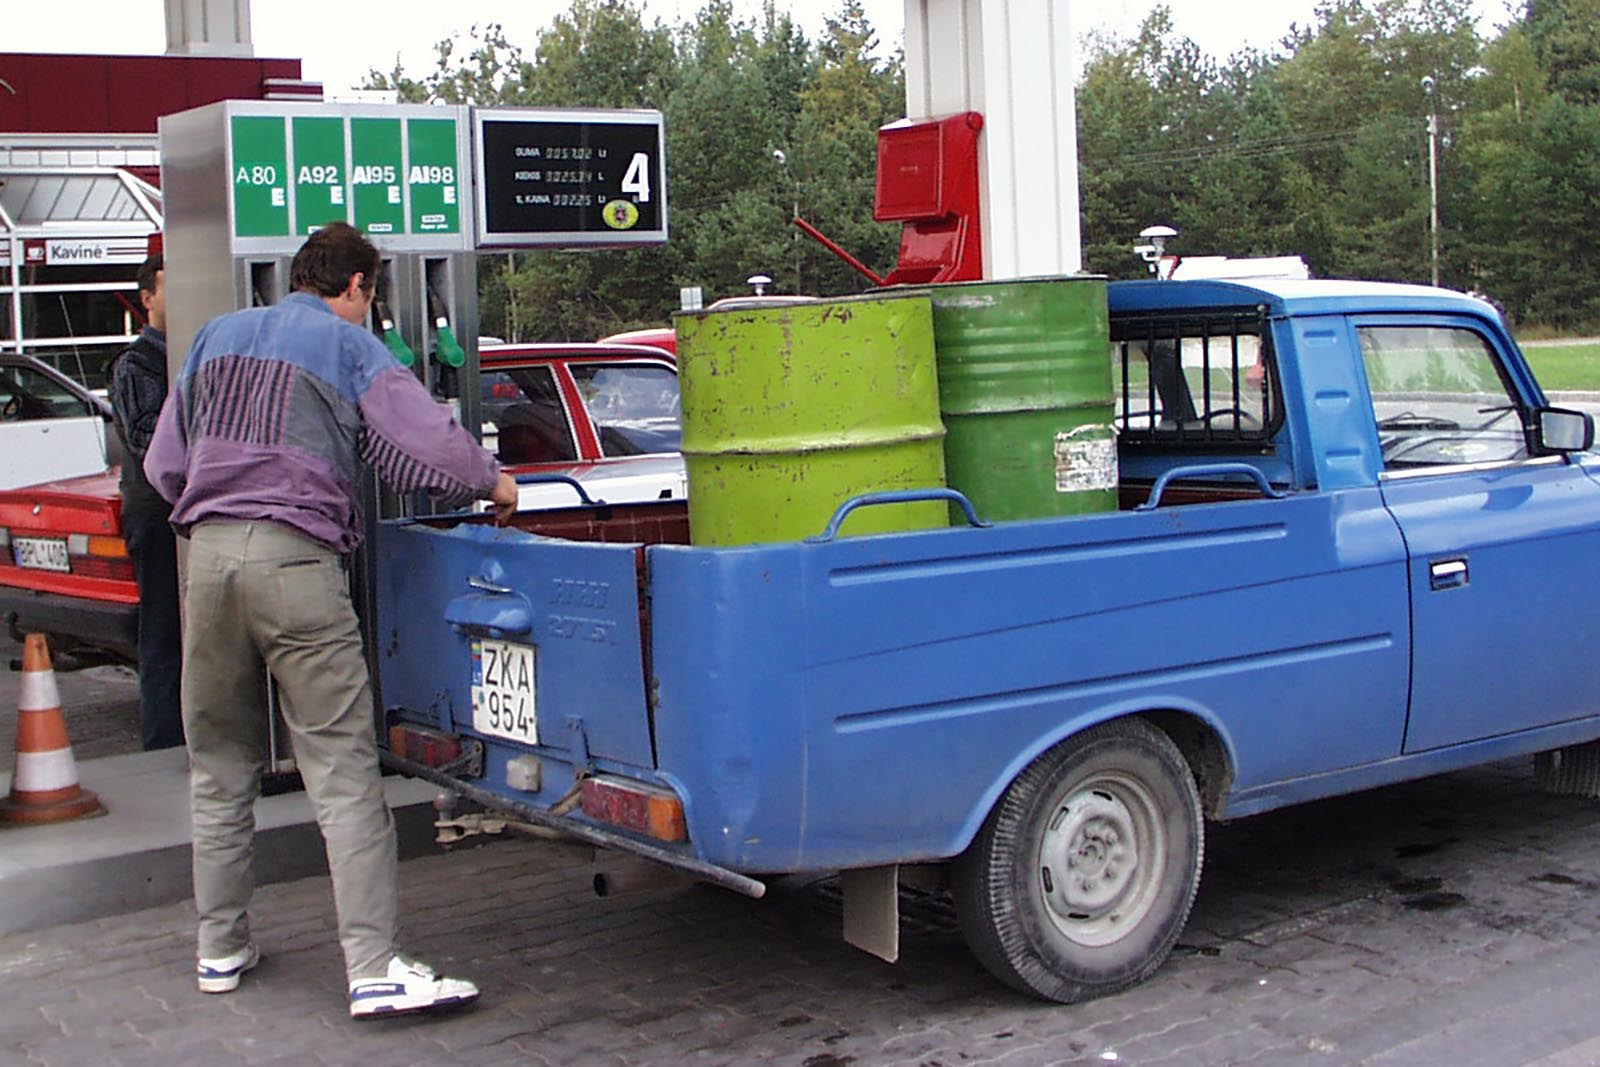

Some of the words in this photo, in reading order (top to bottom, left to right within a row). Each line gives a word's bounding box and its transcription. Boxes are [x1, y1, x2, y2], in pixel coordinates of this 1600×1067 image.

[298, 166, 338, 184] A92
[621, 152, 650, 203] 4
[271, 187, 285, 206] E
[330, 186, 344, 204] E
[388, 185, 401, 204] E
[443, 186, 456, 204] E
[51, 244, 103, 259] Kavinė
[484, 648, 530, 693] ZKA
[488, 691, 528, 736] 954
